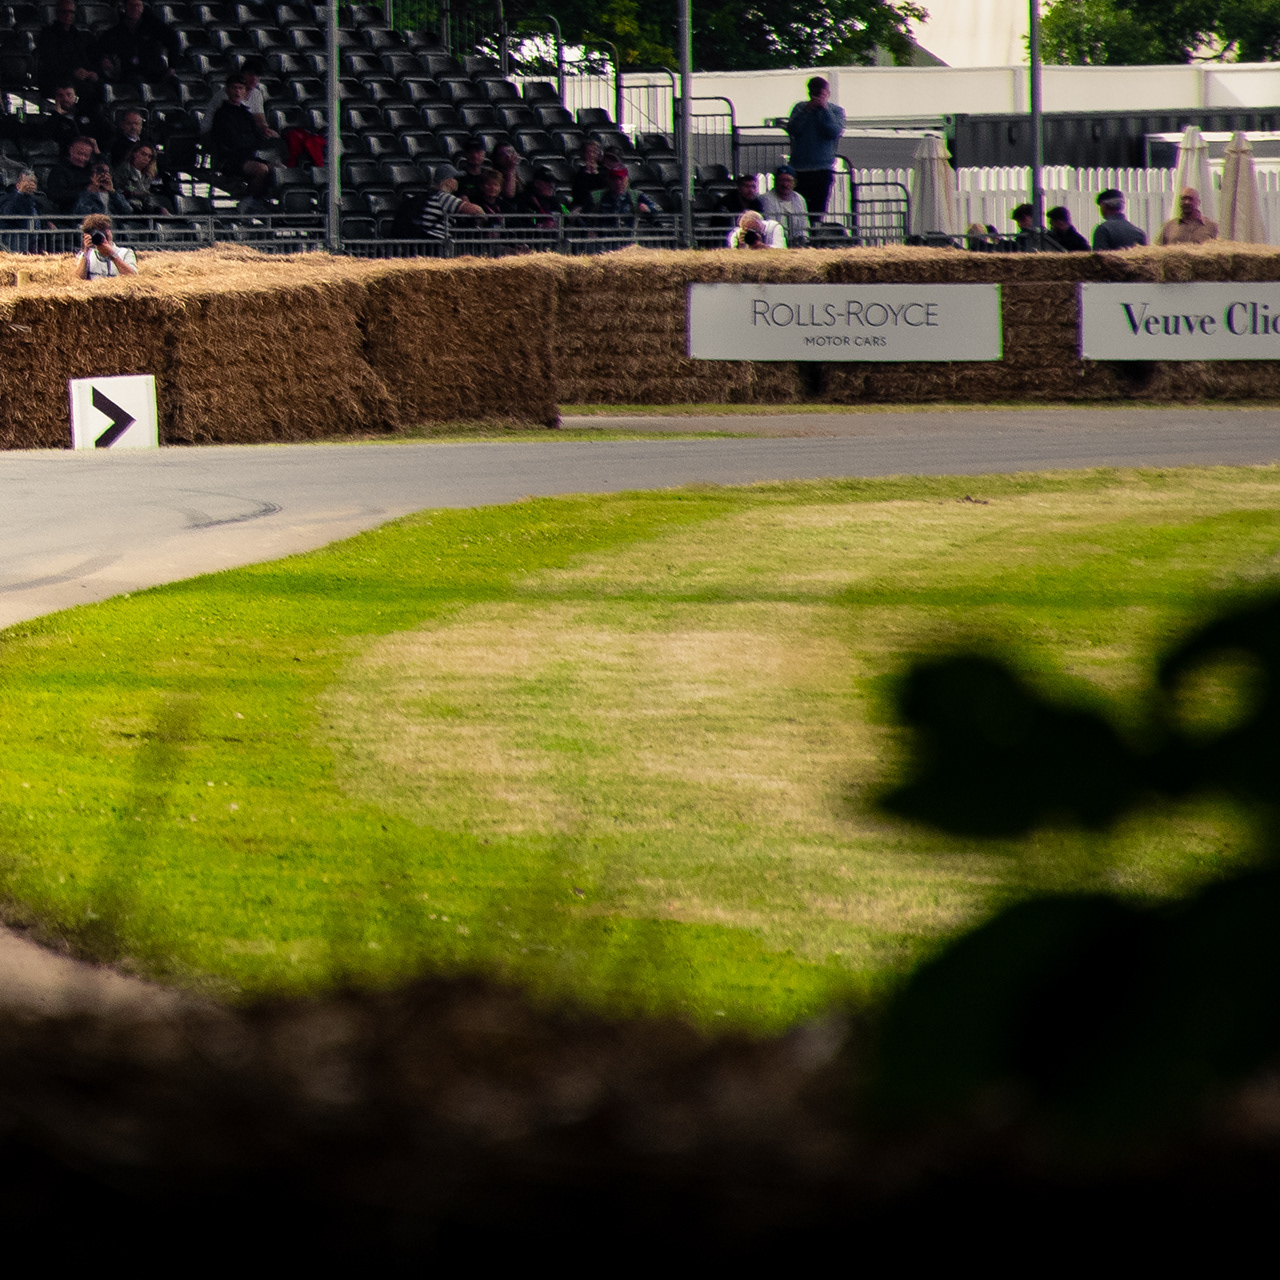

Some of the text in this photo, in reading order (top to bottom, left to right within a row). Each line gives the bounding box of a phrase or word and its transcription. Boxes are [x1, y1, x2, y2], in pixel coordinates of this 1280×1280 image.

[1120, 302, 1217, 336] Veuve
[805, 336, 887, 347] MOTOR CARS
